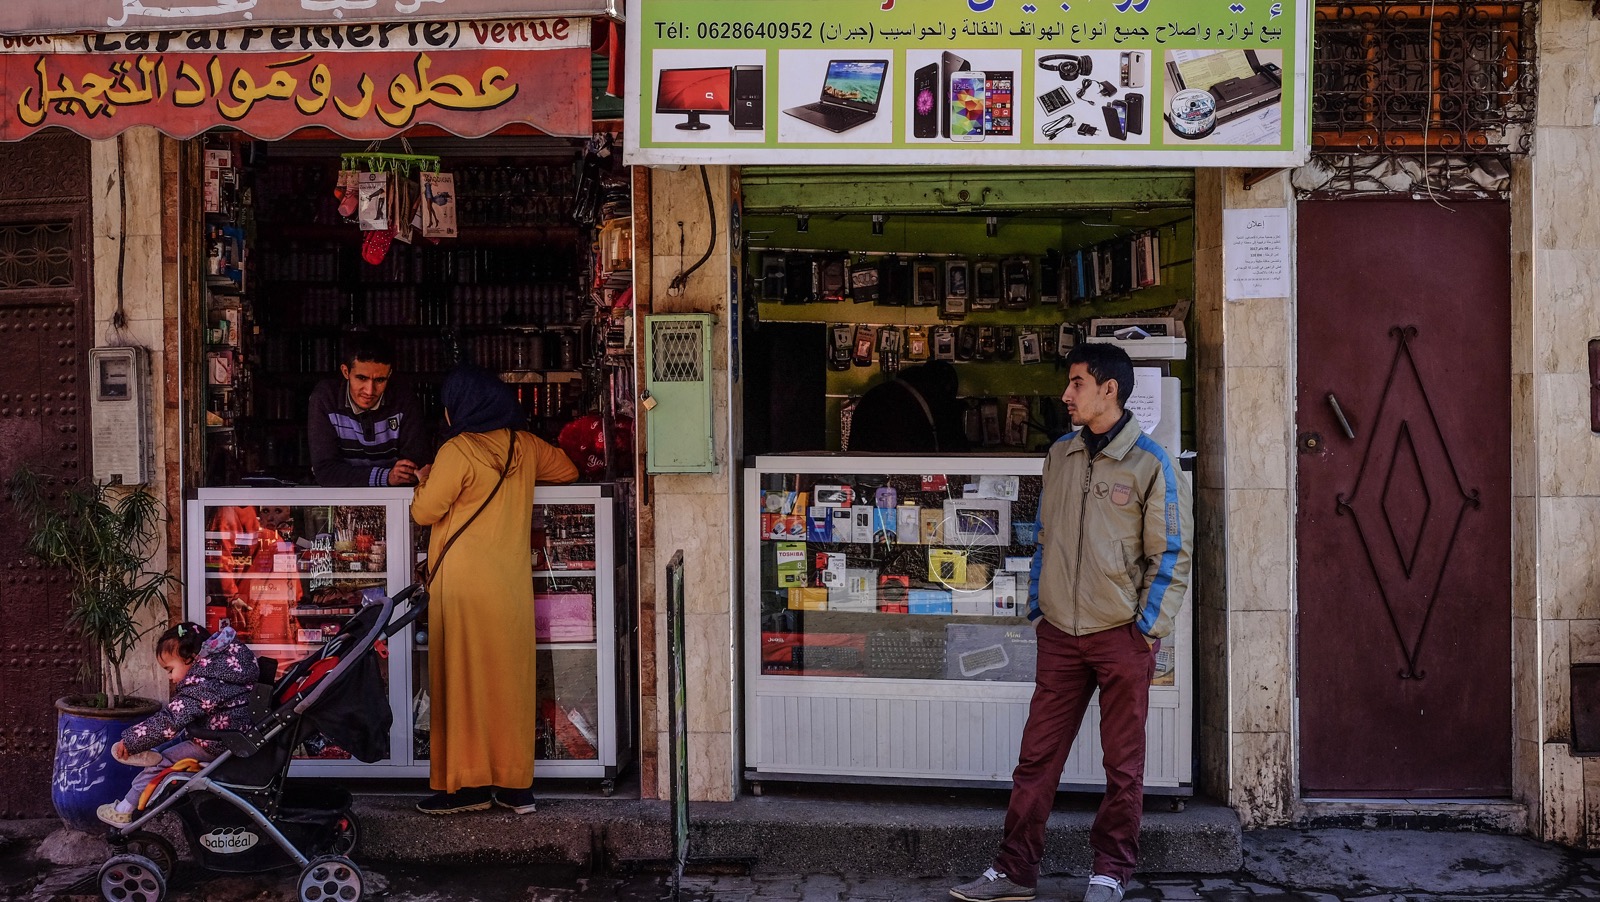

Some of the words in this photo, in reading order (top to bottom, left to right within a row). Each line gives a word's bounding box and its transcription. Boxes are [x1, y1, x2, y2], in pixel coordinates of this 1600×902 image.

[469, 18, 570, 45] venue
[654, 21, 690, 39] Tél:
[698, 21, 813, 40] 0628640952
[819, 20, 875, 43] (جبران)
[879, 21, 956, 42] والحواسيب
[962, 19, 1003, 38] النقالة
[1009, 20, 1064, 41] الهواتف
[1070, 18, 1108, 43] أنواع
[1113, 25, 1150, 44] جميع
[1155, 20, 1211, 43] وإصلاح
[1216, 20, 1255, 43] لوازم
[1259, 20, 1283, 43] بيع
[333, 51, 519, 128] عطور
[1246, 220, 1265, 229] إعلان
[922, 475, 933, 483] 50
[204, 833, 251, 849] babidéal
